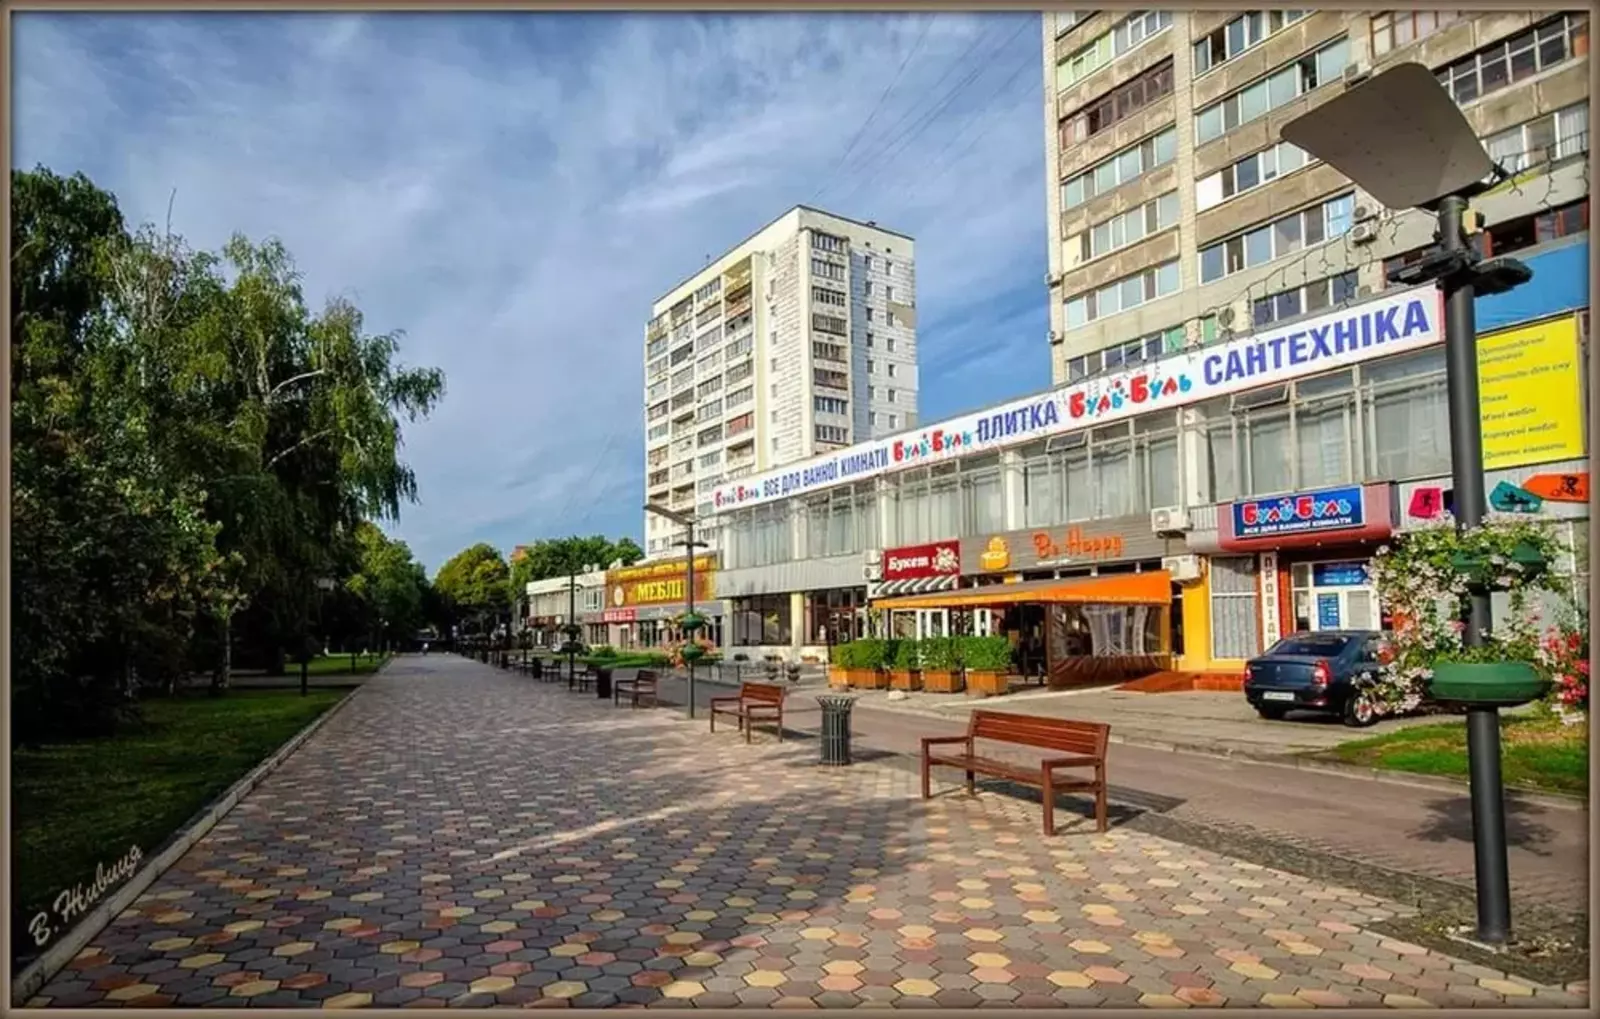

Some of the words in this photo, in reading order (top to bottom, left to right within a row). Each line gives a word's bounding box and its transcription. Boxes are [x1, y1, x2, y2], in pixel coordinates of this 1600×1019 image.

[763, 478, 780, 497] ВСЕ
[782, 472, 801, 496] ДЛЯ
[803, 457, 838, 487] ВАННОЇ
[840, 449, 889, 477] КІМНАТИ
[977, 400, 1059, 443] ПЛИТКА
[1203, 300, 1430, 386] САНТЕХНІКА
[1067, 526, 1122, 560] Happy
[888, 555, 929, 572] Букет
[637, 579, 682, 602] МЕБЛІ
